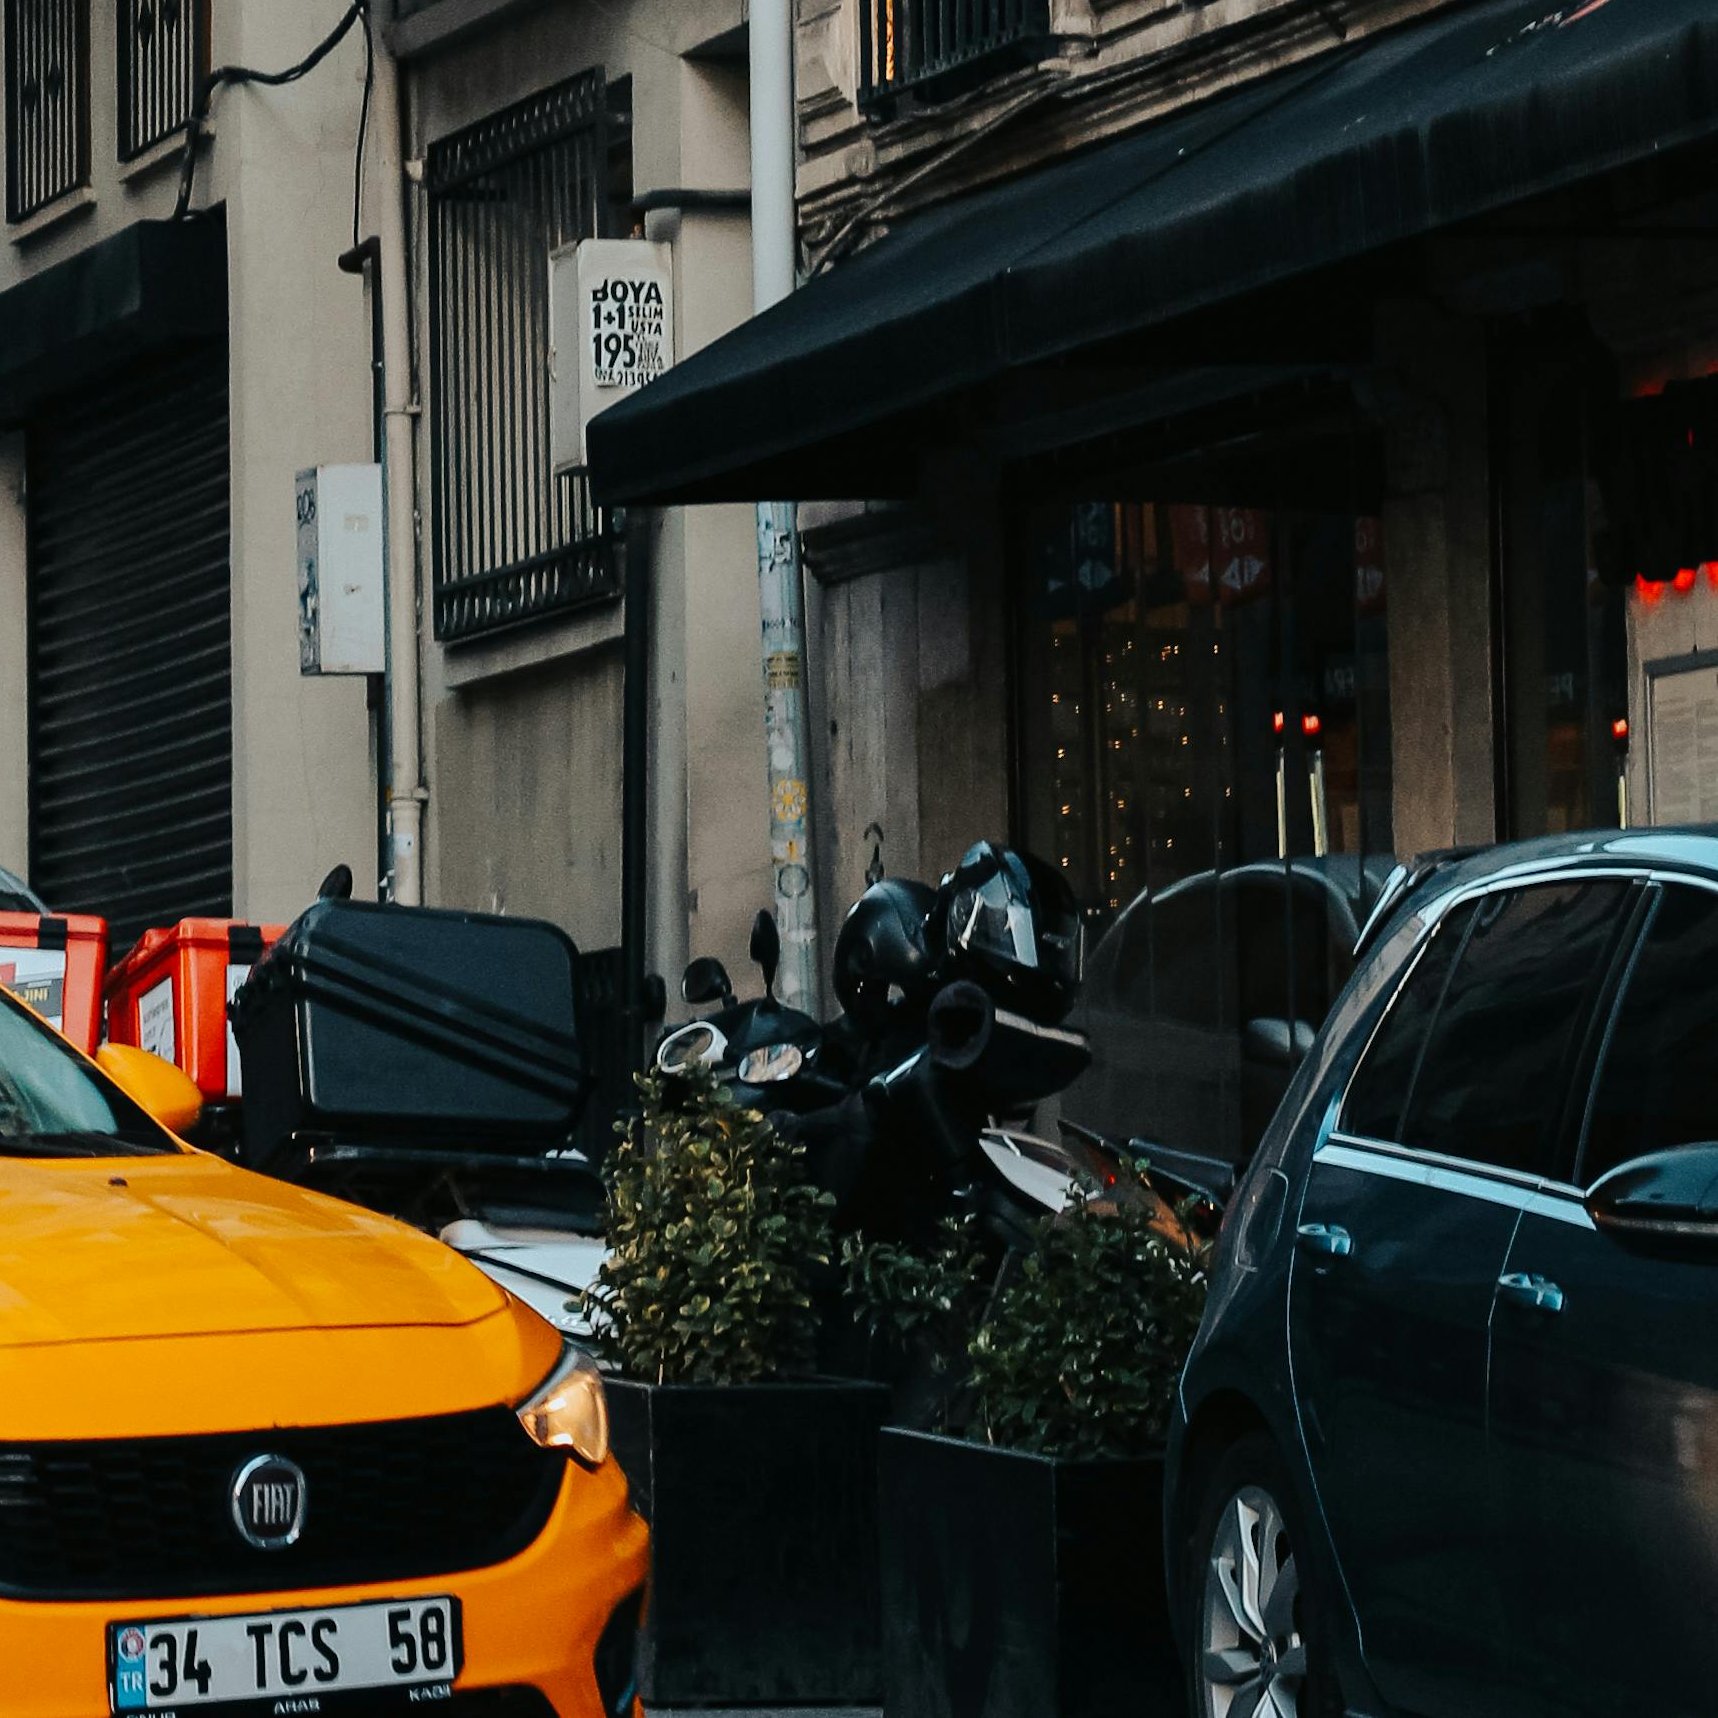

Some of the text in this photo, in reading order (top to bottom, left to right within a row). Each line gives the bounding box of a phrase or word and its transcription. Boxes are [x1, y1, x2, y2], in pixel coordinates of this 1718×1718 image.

[593, 303, 626, 329] 1+1
[631, 320, 662, 336] USTA
[593, 333, 636, 368] 195
[253, 1483, 295, 1524] FIAT
[120, 1606, 447, 1697] TR 34 TCS 58
